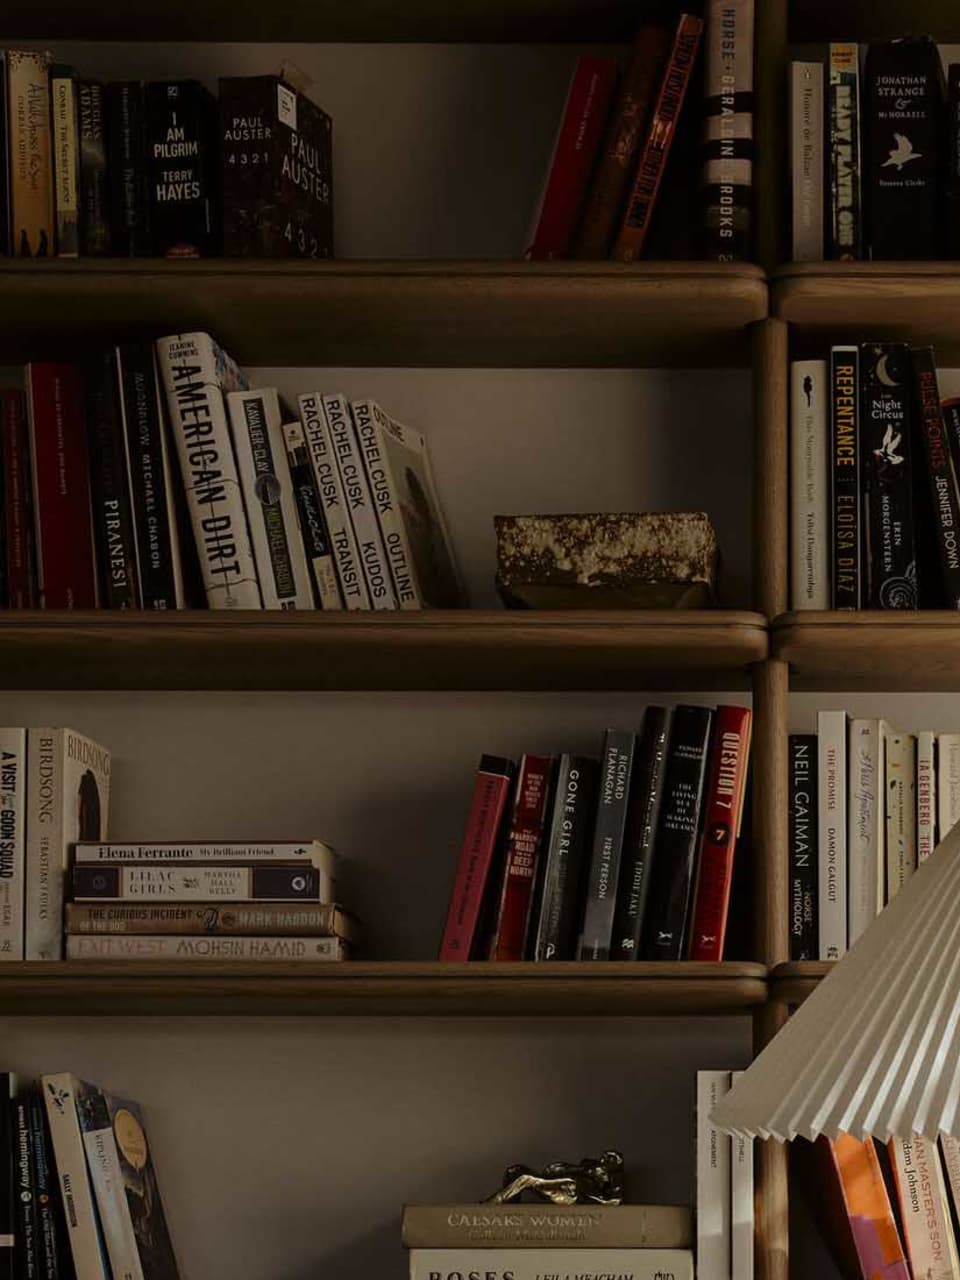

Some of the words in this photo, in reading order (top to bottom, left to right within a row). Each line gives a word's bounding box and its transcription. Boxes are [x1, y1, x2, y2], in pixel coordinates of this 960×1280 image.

[720, 8, 735, 61] HORSE
[875, 75, 927, 87] JONATHAN
[877, 86, 925, 97] STRANGE
[166, 128, 184, 141] AM
[171, 111, 177, 126] I
[224, 128, 272, 141] AUSTER
[232, 117, 264, 129] PAUL
[153, 141, 199, 159] PILGRIM
[290, 132, 322, 175] PAUL
[156, 182, 201, 201] HAYES
[162, 169, 194, 181] TERRY
[836, 364, 855, 467] REPENTANCE
[871, 409, 905, 420] Circus
[872, 400, 902, 411] Night
[170, 363, 227, 506] AMERICAN
[201, 516, 242, 576] DIRT
[301, 397, 322, 460] RACHEL
[317, 462, 339, 509] CUSK
[332, 525, 361, 598] TRANSIT
[326, 399, 351, 464] RACHEL
[342, 464, 365, 510] CUSK
[361, 541, 386, 599] KUDOS
[354, 404, 378, 469] RACHEL
[370, 468, 394, 514] CUSK
[386, 532, 415, 603] OUTLINE
[934, 475, 954, 529] JENNIFER
[103, 499, 128, 589] PIRANESI
[943, 529, 960, 570] DOWN
[603, 746, 618, 805] FLANAGAN
[615, 754, 628, 801] RICHARD
[716, 731, 741, 797] QUESTION
[793, 744, 809, 786] NEIL
[828, 748, 836, 771] THE
[38, 737, 54, 825] BIRDSONG
[566, 769, 580, 813] GONE
[828, 772, 836, 811] PROMISE
[919, 774, 931, 826] GENBERG
[558, 820, 573, 857] GIRL
[794, 791, 810, 869] GAIMAN
[828, 828, 836, 864] DAMON
[920, 834, 931, 857] THE
[98, 846, 134, 859] Elena
[138, 846, 194, 859] Ferrante
[212, 847, 245, 857] Brilliant
[248, 847, 275, 857] Friend
[602, 836, 613, 862] FIRST
[129, 883, 176, 895] GIRLS
[130, 871, 176, 883] LILAC
[211, 879, 235, 887] HALL
[828, 865, 837, 902] GALGUT
[88, 906, 105, 919] THE
[108, 906, 147, 920] CURIOUS
[150, 906, 192, 919] INCIDENT
[239, 909, 273, 923] MARK
[276, 909, 325, 924] HADDON
[792, 880, 803, 936] MYTHOLOGY
[176, 939, 244, 958] MOHSIN
[249, 940, 306, 958] HAMID
[18, 1128, 32, 1189] hemingway
[904, 1164, 921, 1213] Johnson
